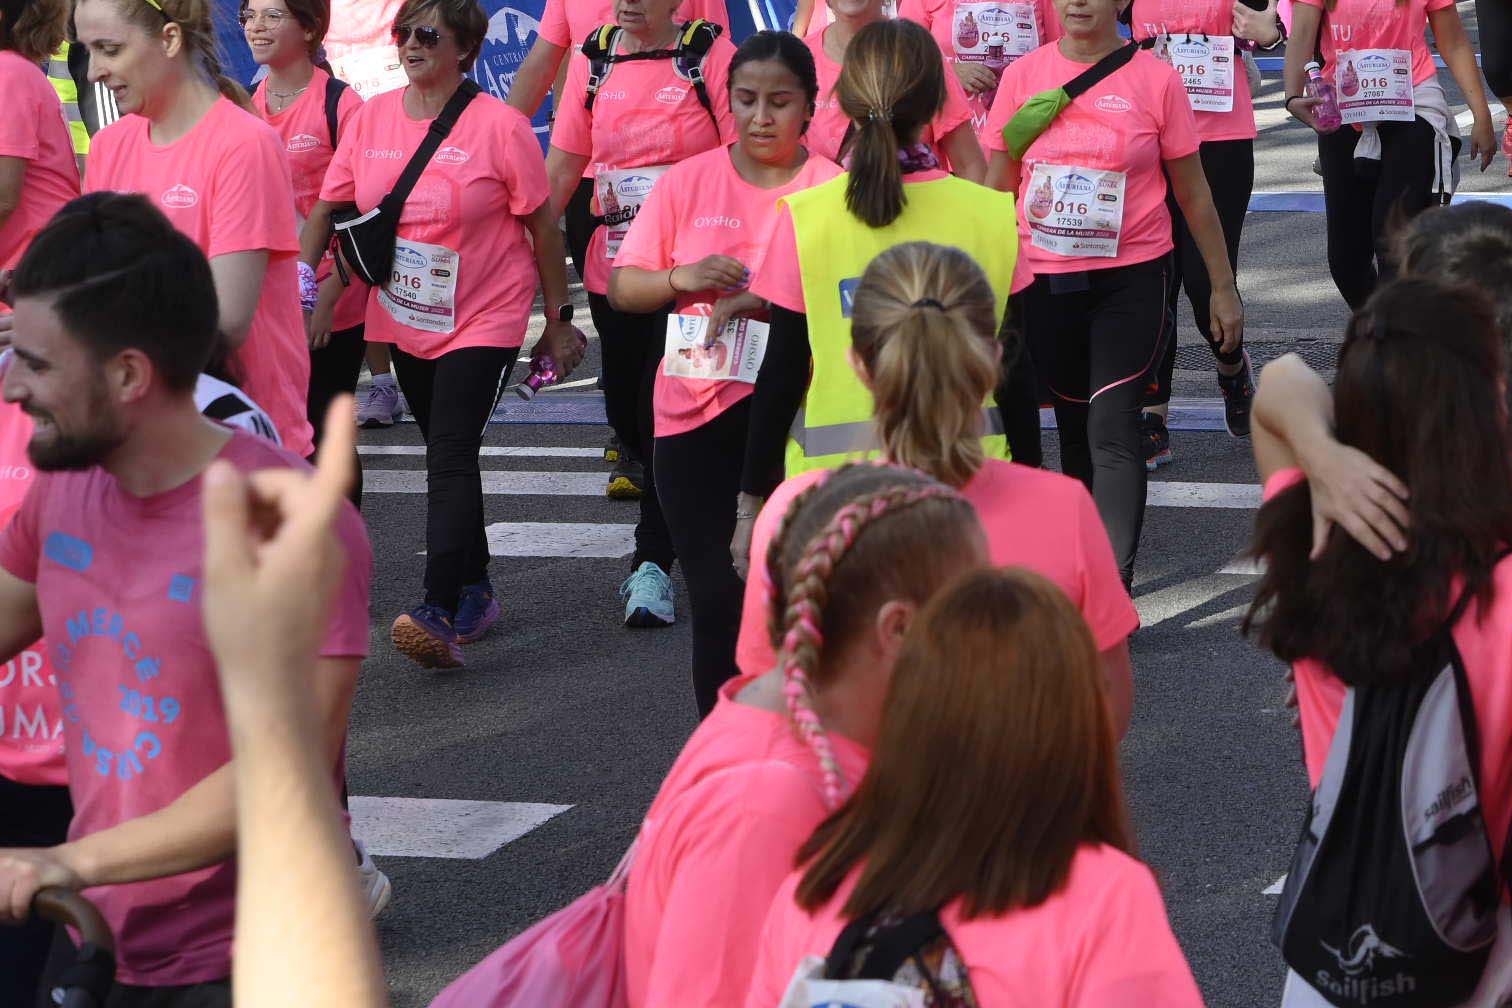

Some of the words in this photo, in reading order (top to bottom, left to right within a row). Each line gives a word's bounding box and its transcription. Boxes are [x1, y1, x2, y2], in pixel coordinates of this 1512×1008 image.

[982, 32, 1010, 43] 06
[1331, 24, 1351, 41] TU
[1176, 64, 1206, 75] 016
[1361, 77, 1388, 89] 016
[364, 149, 403, 160] OYSHO
[1054, 201, 1088, 215] 016
[694, 215, 741, 230] OYSHO
[1057, 217, 1083, 228] 17539
[393, 270, 421, 289] 016
[394, 287, 417, 300] 17540
[416, 315, 447, 327] Santander
[746, 334, 760, 370] OYSHO
